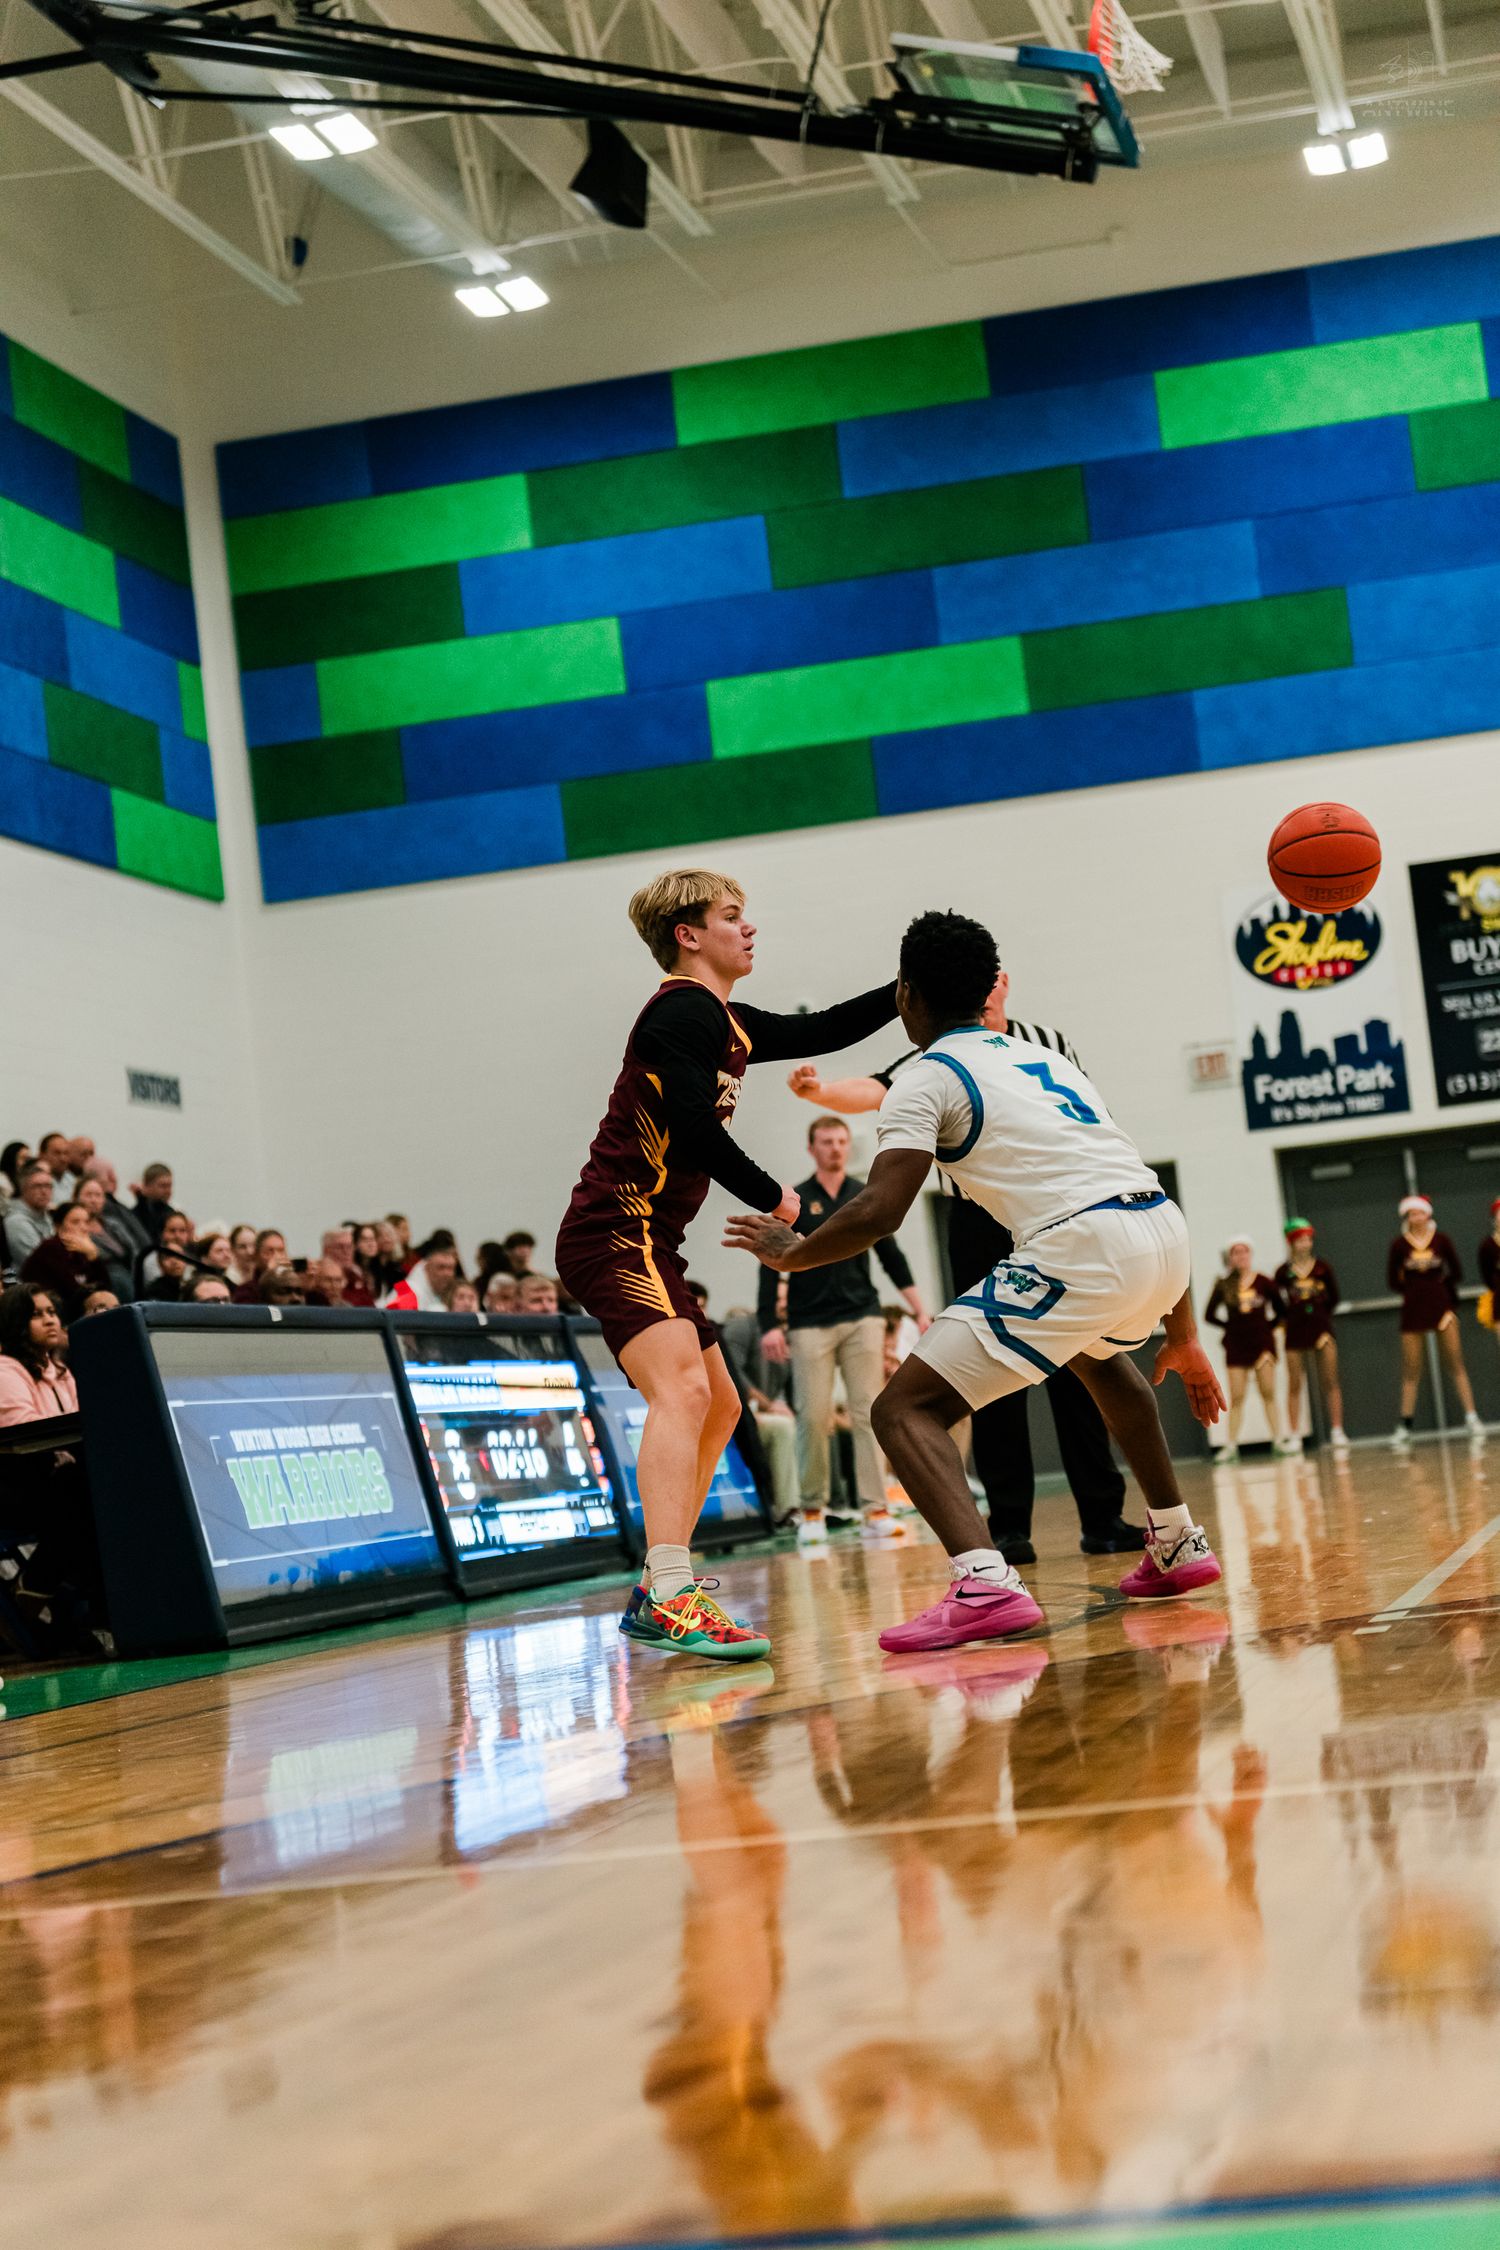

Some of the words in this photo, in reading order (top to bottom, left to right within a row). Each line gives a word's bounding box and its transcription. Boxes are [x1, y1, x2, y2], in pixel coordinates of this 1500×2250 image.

[129, 1070, 181, 1107] VISITORS
[1012, 1061, 1101, 1125] 3
[1254, 1069, 1335, 1104] Forest
[1335, 1060, 1396, 1095] Park
[1270, 1105, 1294, 1123] It's
[1294, 1101, 1345, 1121] Skyline
[226, 1447, 394, 1530] WARRIORS
